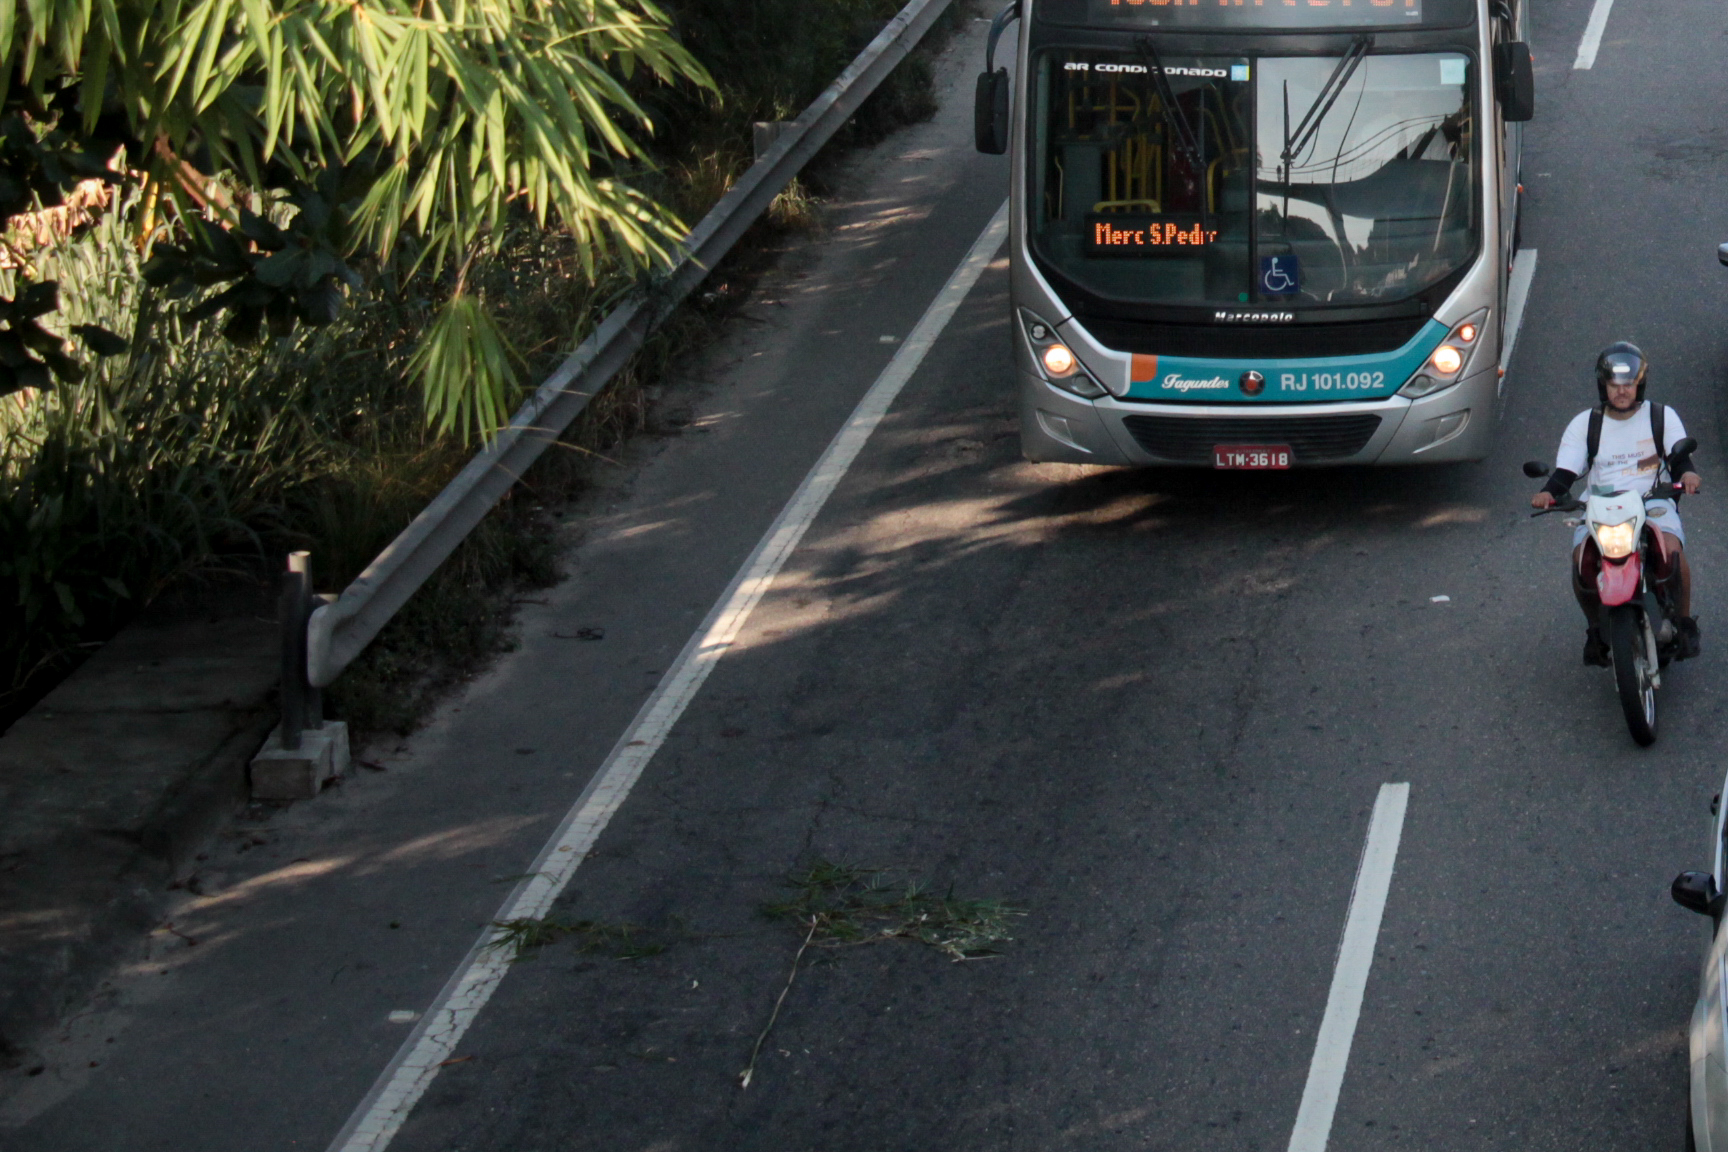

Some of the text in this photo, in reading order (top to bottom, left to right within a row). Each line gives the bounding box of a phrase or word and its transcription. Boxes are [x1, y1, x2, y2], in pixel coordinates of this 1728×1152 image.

[1095, 222, 1145, 245] Merc
[1214, 311, 1293, 323] Marcopolo
[1161, 374, 1230, 392] Fagundes
[1280, 372, 1385, 391] RJ 101.092
[1627, 451, 1645, 459] MUST
